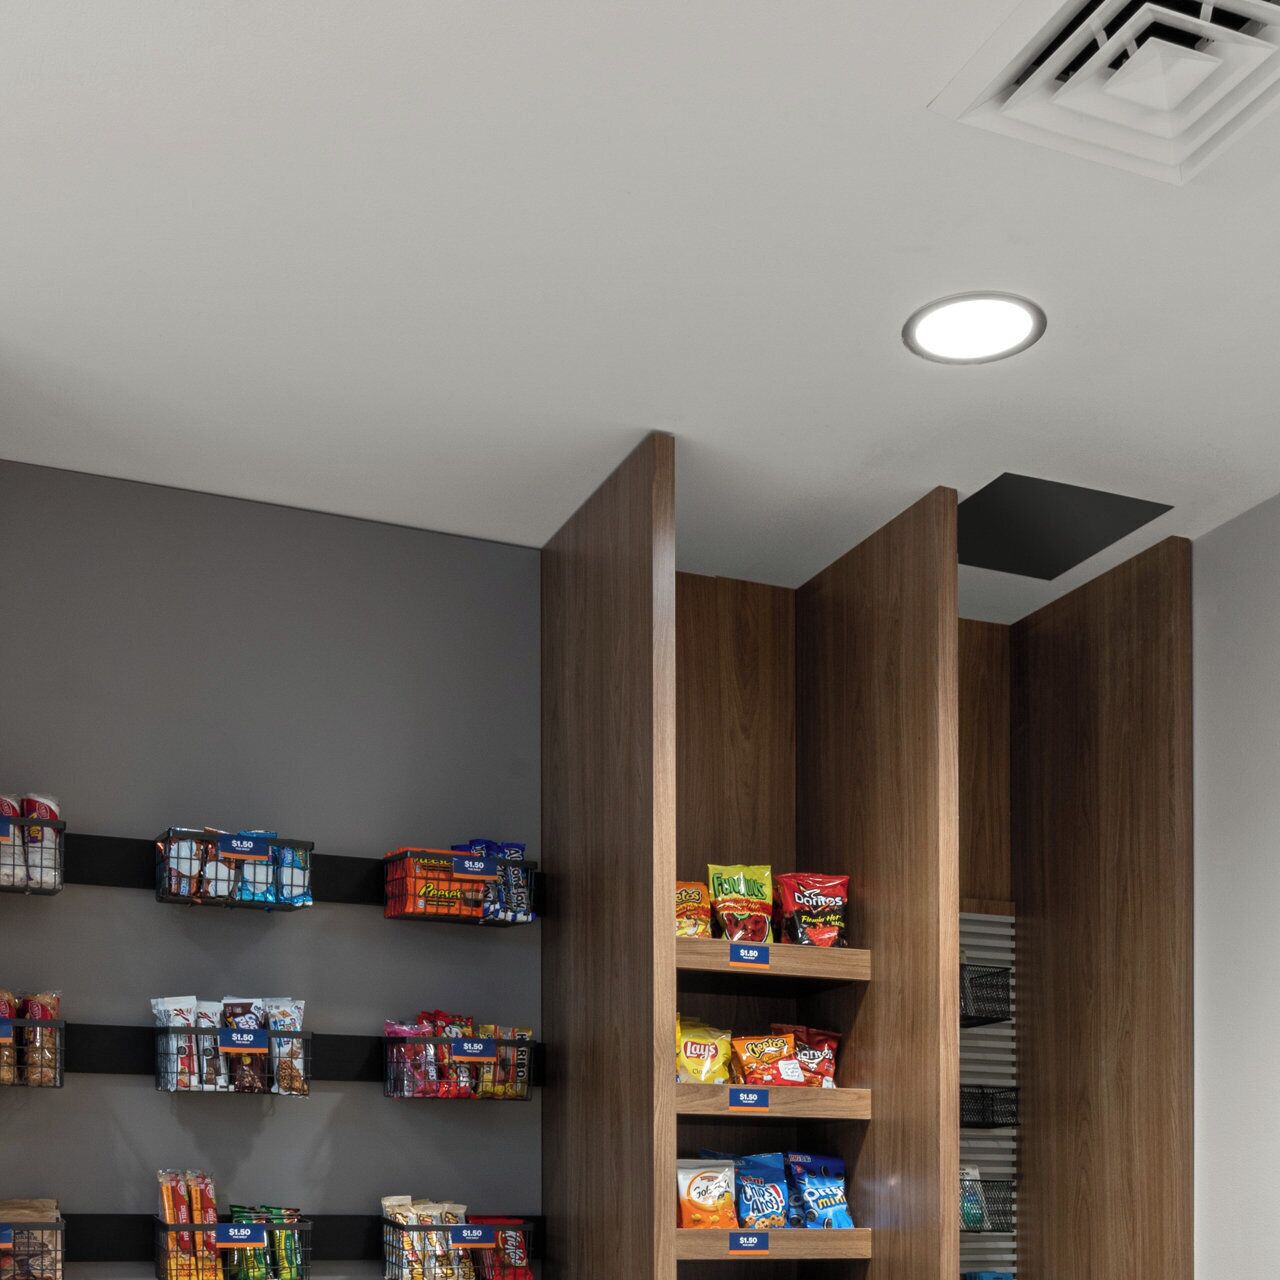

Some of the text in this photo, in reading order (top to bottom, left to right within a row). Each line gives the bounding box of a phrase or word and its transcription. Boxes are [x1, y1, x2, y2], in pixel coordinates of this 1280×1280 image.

[232, 839, 253, 848] $1.50
[464, 860, 484, 869] $1.50
[419, 883, 462, 899] Reese's
[794, 892, 842, 906] Doritos
[740, 949, 758, 958] $1.50
[232, 1033, 254, 1042] $1.50
[463, 1043, 483, 1051] $1.50
[686, 1041, 716, 1060] Lay's
[747, 1038, 785, 1057] Cheetos
[517, 1032, 528, 1080] HRIBO
[740, 1093, 758, 1101] $1.50
[744, 1185, 771, 1202] Chips
[229, 1228, 251, 1236] $1.50
[740, 1236, 758, 1244] $1.50
